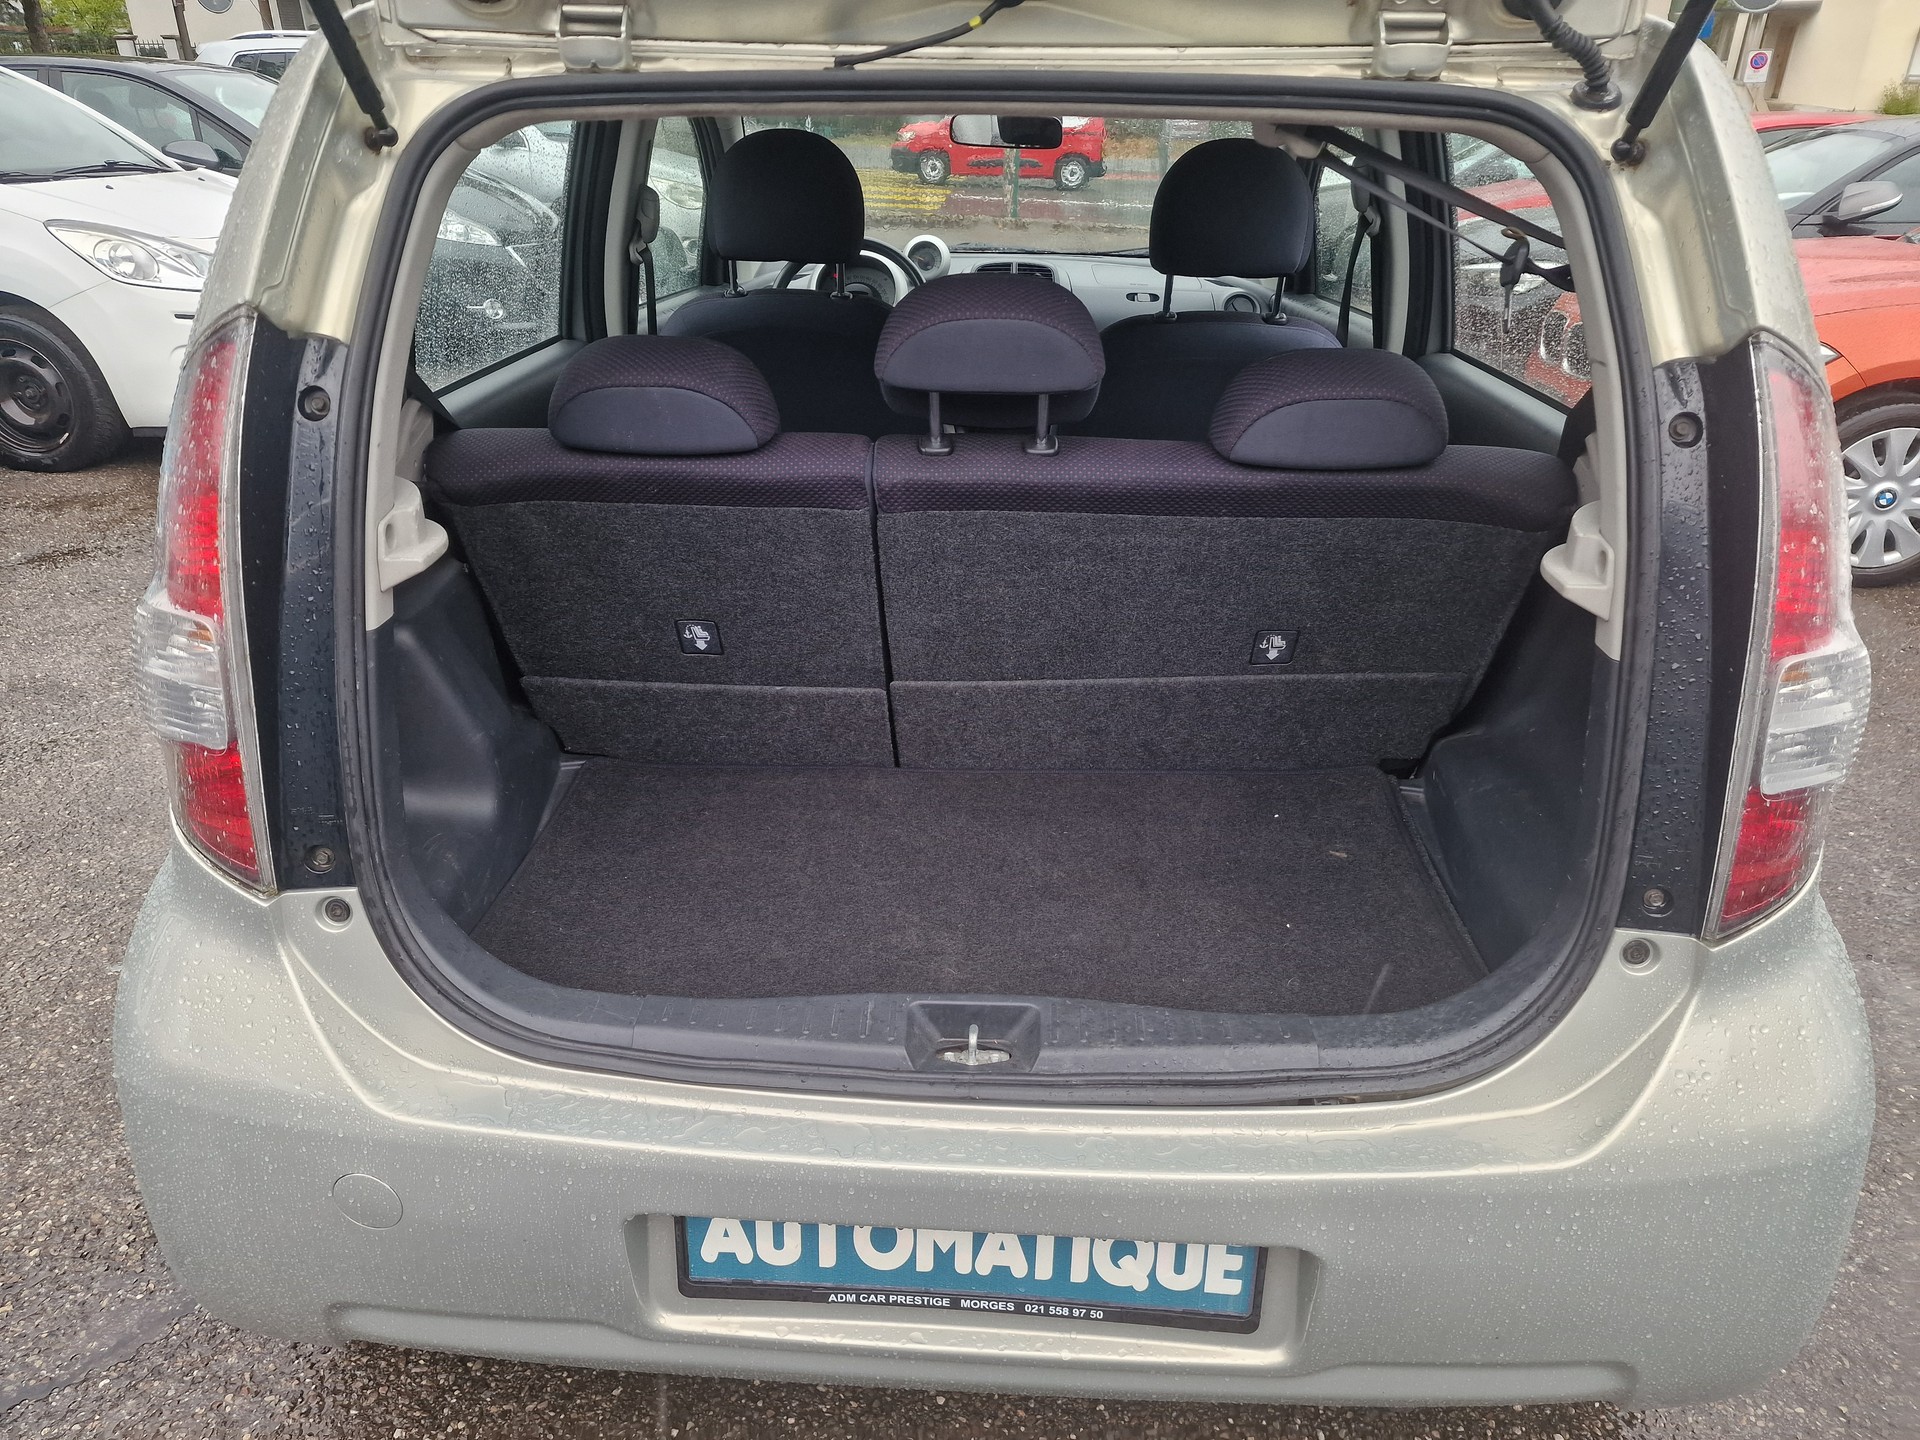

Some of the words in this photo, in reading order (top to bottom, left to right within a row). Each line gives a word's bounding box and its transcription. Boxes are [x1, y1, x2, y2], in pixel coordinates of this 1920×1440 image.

[828, 1293, 856, 1302] ADM
[859, 1294, 886, 1303] CAR
[889, 1295, 951, 1307] PRESTIGE
[960, 1299, 1015, 1311] MORGES
[1024, 1304, 1044, 1314] 021
[1048, 1306, 1069, 1316] 558
[1072, 1308, 1086, 1317] 97
[1089, 1310, 1104, 1319] 50
